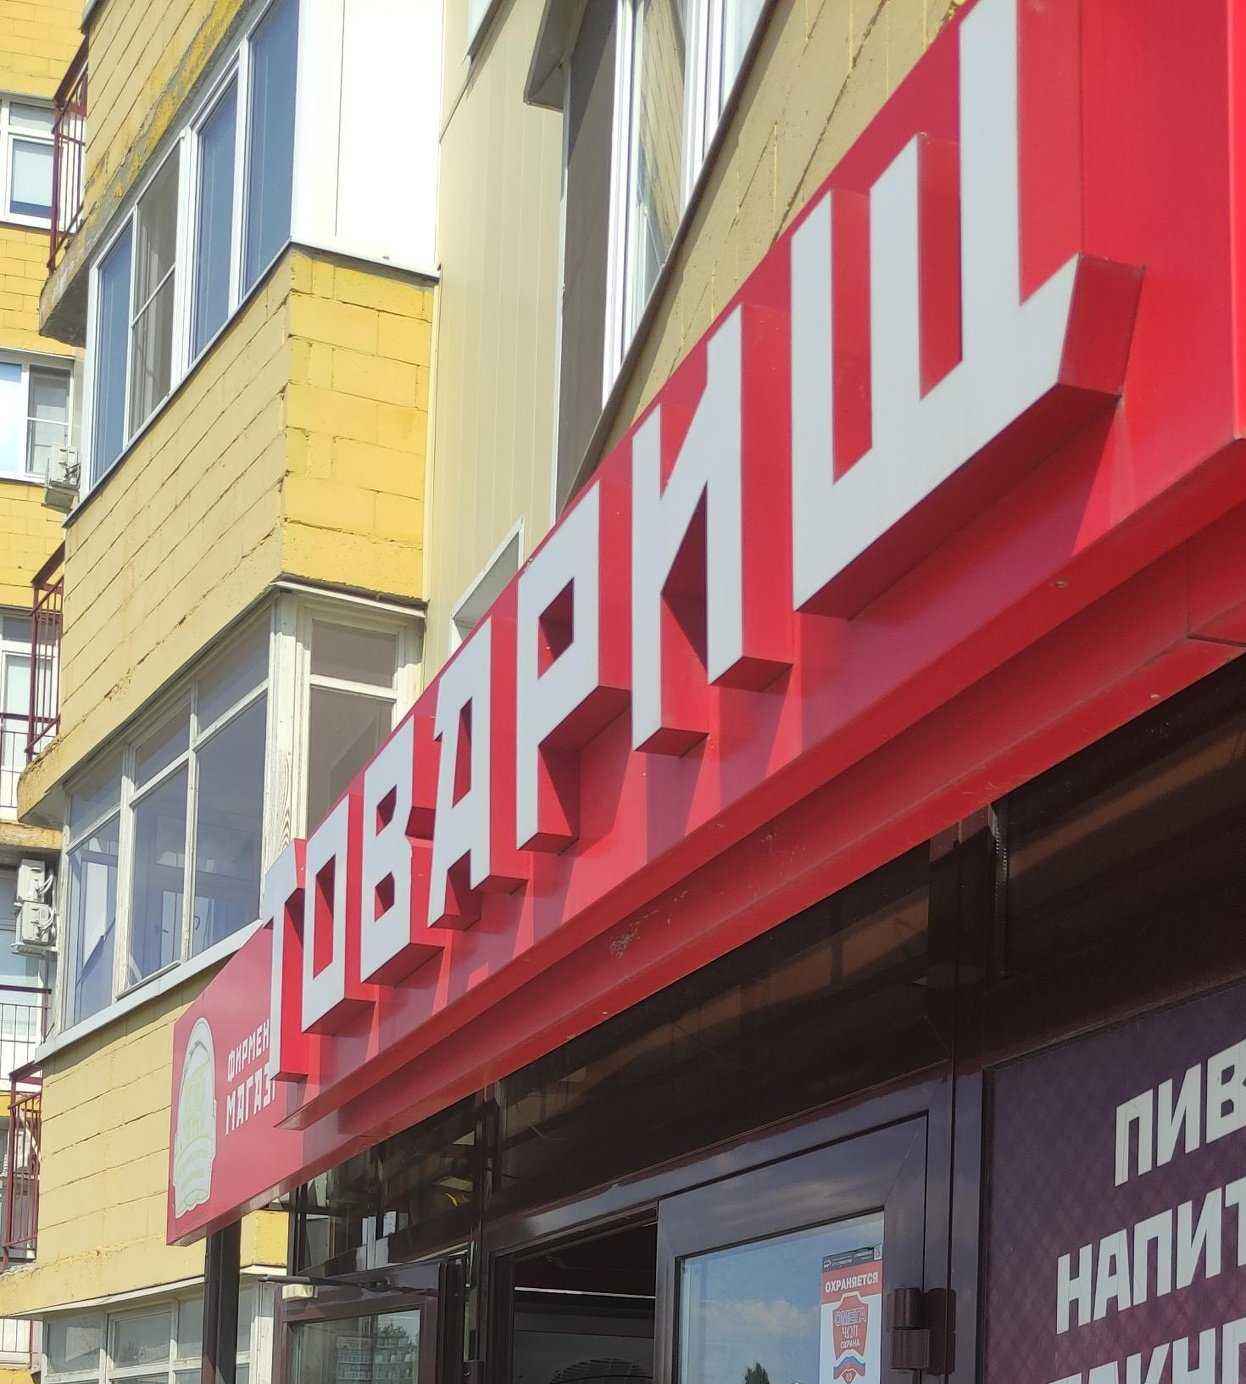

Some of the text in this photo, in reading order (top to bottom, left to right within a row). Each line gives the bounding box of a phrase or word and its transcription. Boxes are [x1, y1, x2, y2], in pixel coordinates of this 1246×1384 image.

[261, 0, 1081, 1080] ТОВАРИЩ
[1114, 1038, 1246, 1187] ПИВ
[825, 1271, 879, 1293] ОХРАНЯЕТСЯ
